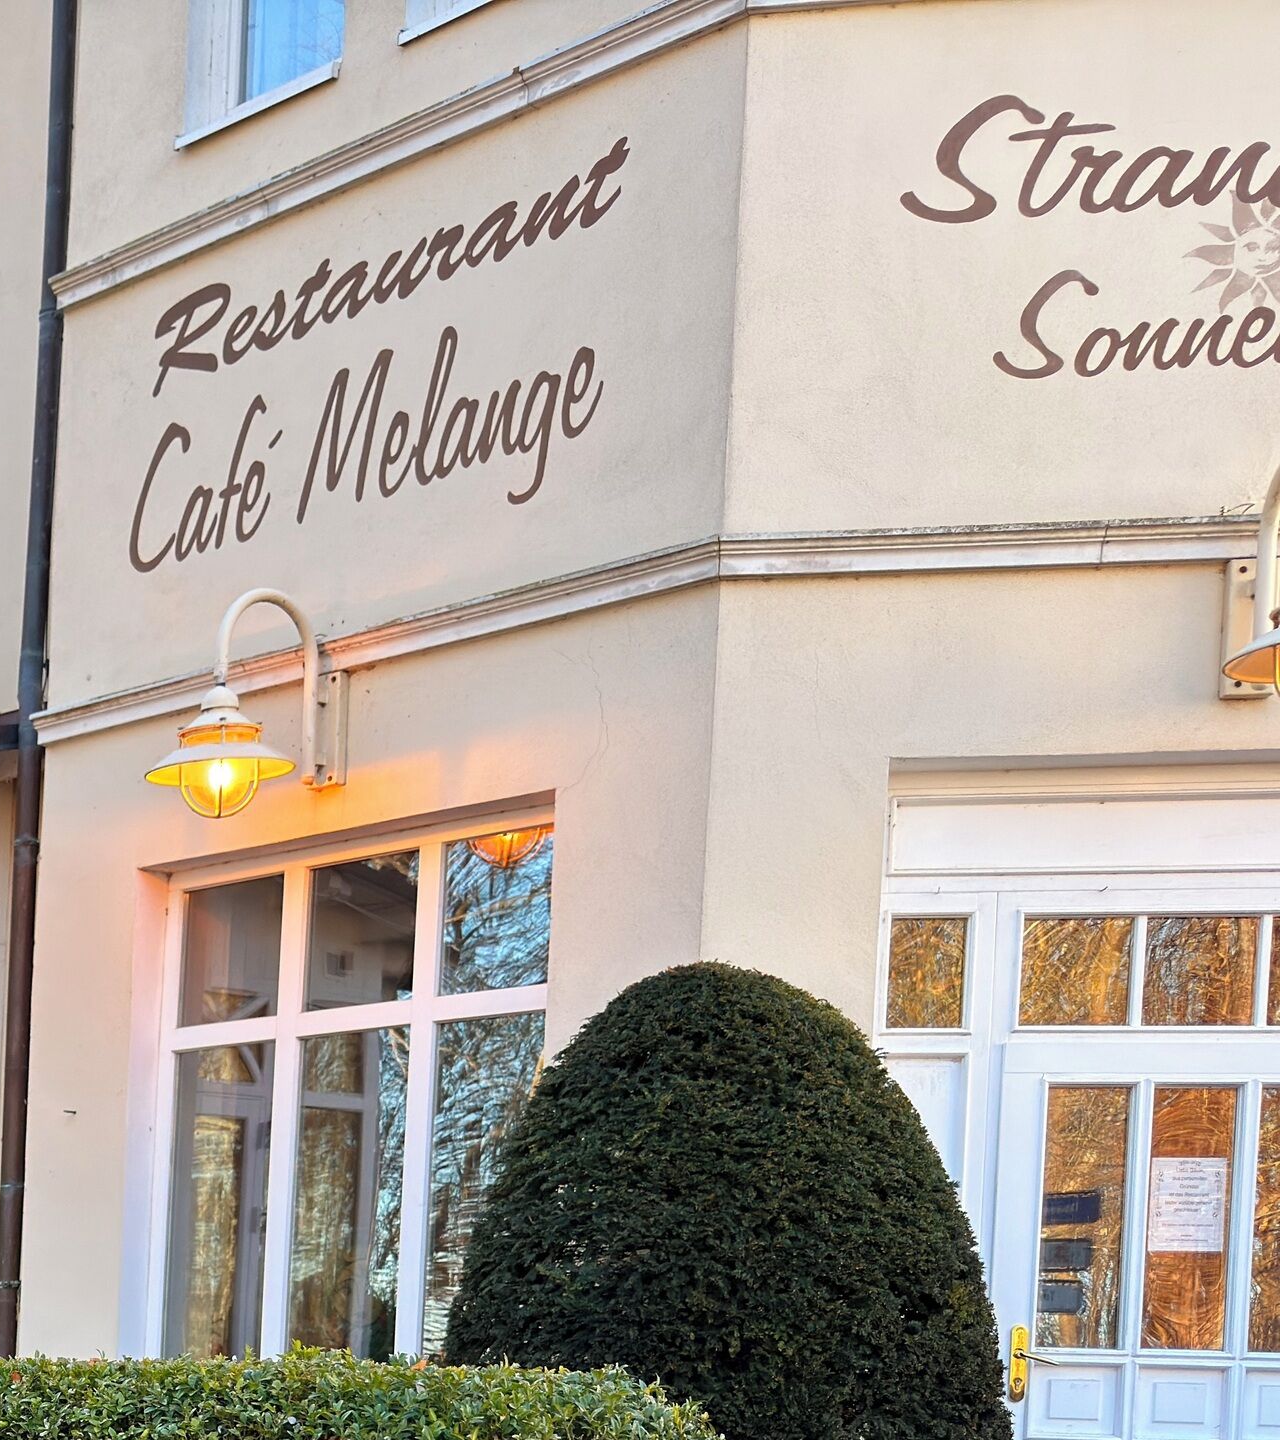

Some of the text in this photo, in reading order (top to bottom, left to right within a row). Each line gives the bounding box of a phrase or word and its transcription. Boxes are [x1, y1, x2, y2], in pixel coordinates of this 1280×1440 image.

[899, 93, 1280, 225] Stran
[152, 135, 631, 398] Restaurant
[992, 268, 1280, 380] Sonne
[128, 325, 604, 573] Café Melange
